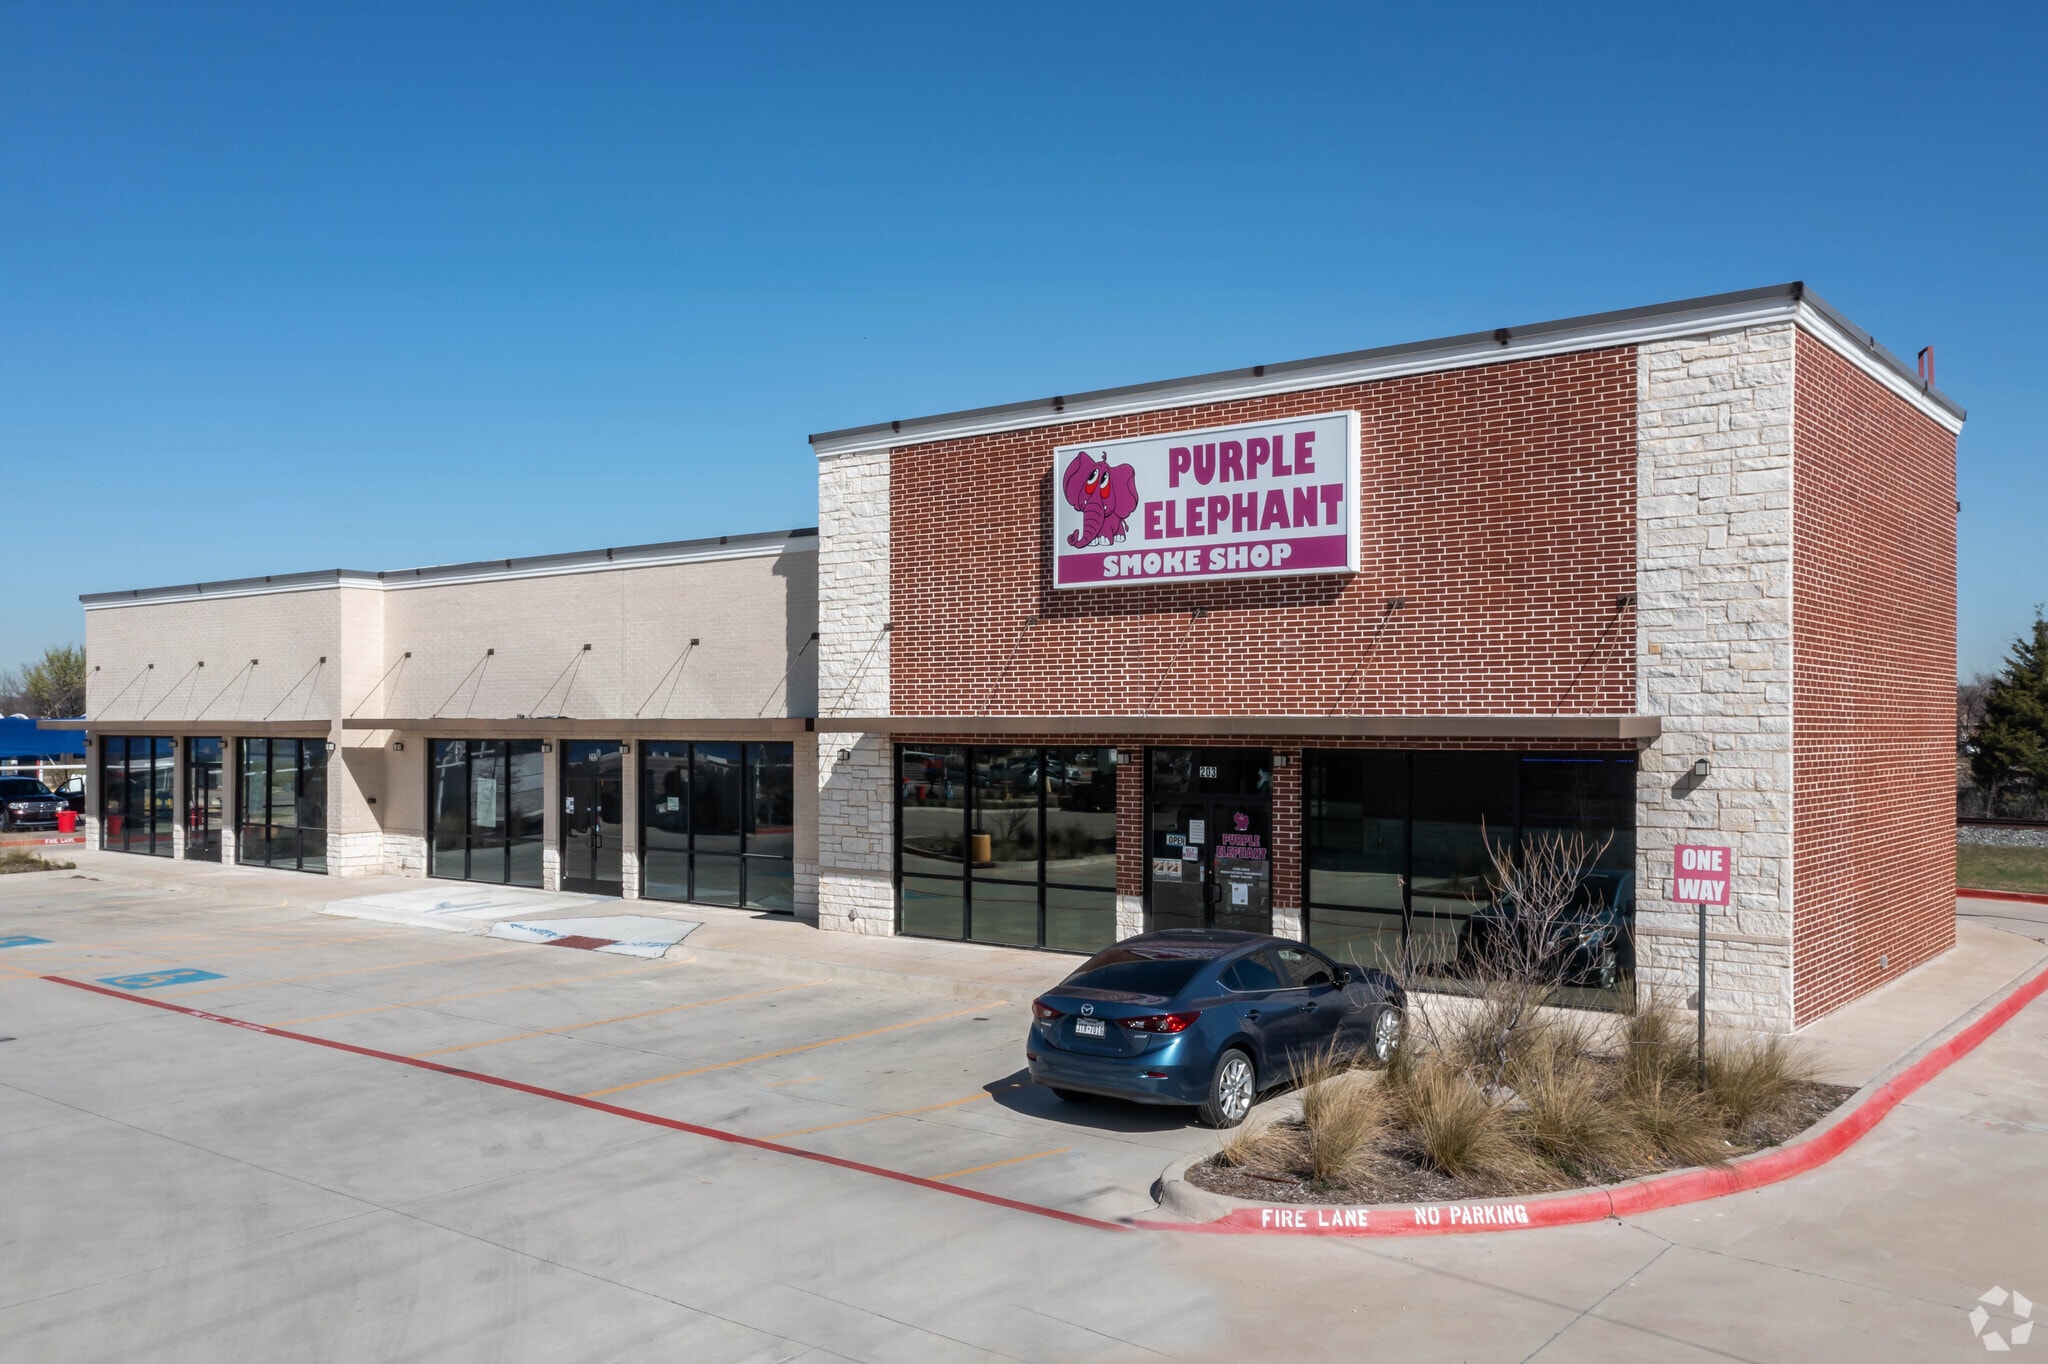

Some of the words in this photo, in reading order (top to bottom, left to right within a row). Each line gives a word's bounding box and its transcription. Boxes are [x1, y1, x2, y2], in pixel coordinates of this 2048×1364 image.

[1169, 431, 1316, 488] PURPLE
[1144, 483, 1344, 540] ELEPHANT
[1103, 550, 1201, 577] SMOKE
[1209, 543, 1292, 571] SHOP
[1200, 766, 1216, 778] 203
[1168, 836, 1185, 845] OPEN
[1222, 833, 1260, 846] PURPLE
[1216, 845, 1267, 860] ELEPHANT
[1682, 848, 1723, 872] ONE
[1678, 878, 1726, 902] WAY
[1261, 1209, 1307, 1228] FIRE
[1318, 1209, 1370, 1228] LANE
[1414, 1206, 1440, 1226] NO
[1450, 1204, 1529, 1226] PARKING
